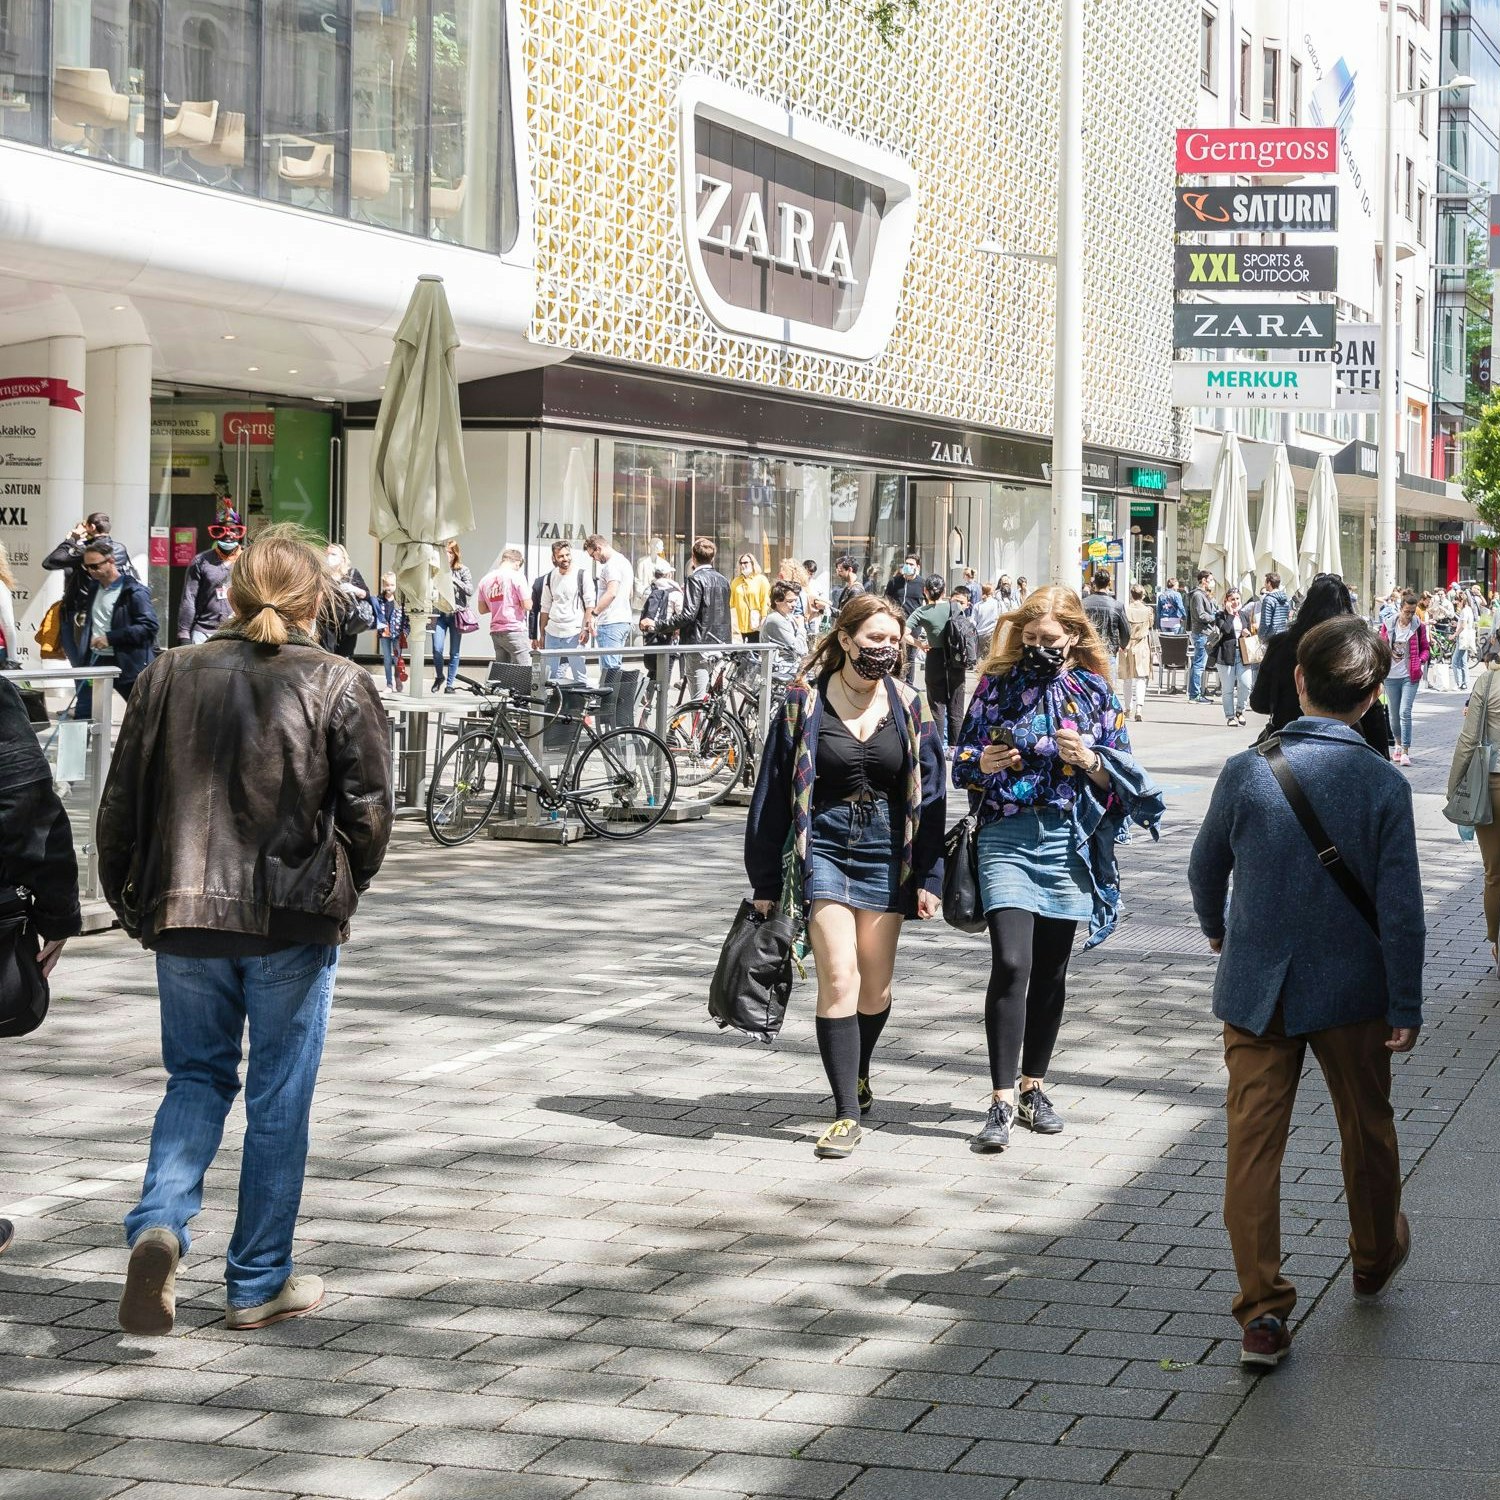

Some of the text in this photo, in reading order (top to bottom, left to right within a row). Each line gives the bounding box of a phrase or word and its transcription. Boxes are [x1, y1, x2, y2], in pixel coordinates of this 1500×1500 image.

[1303, 33, 1323, 82] Galaxy
[1185, 133, 1329, 168] Gerngross
[1232, 193, 1332, 223] SATURN
[696, 173, 859, 285] ZARA
[1188, 253, 1240, 283] XXL
[1243, 253, 1304, 267] SPORTS &
[1242, 269, 1310, 283] OUTDOOR
[1192, 314, 1323, 337] ZARA
[1207, 370, 1299, 388] MERKUR
[1206, 391, 1299, 400] Ihr Markt
[179, 419, 200, 427] WELT
[930, 440, 974, 466] ZARA
[4, 483, 41, 495] SATURN
[1134, 467, 1168, 490] MERKUR
[537, 522, 587, 541] ZARA
[1419, 533, 1443, 541] Street
[1443, 533, 1461, 541] One
[515, 736, 542, 773] TREK
